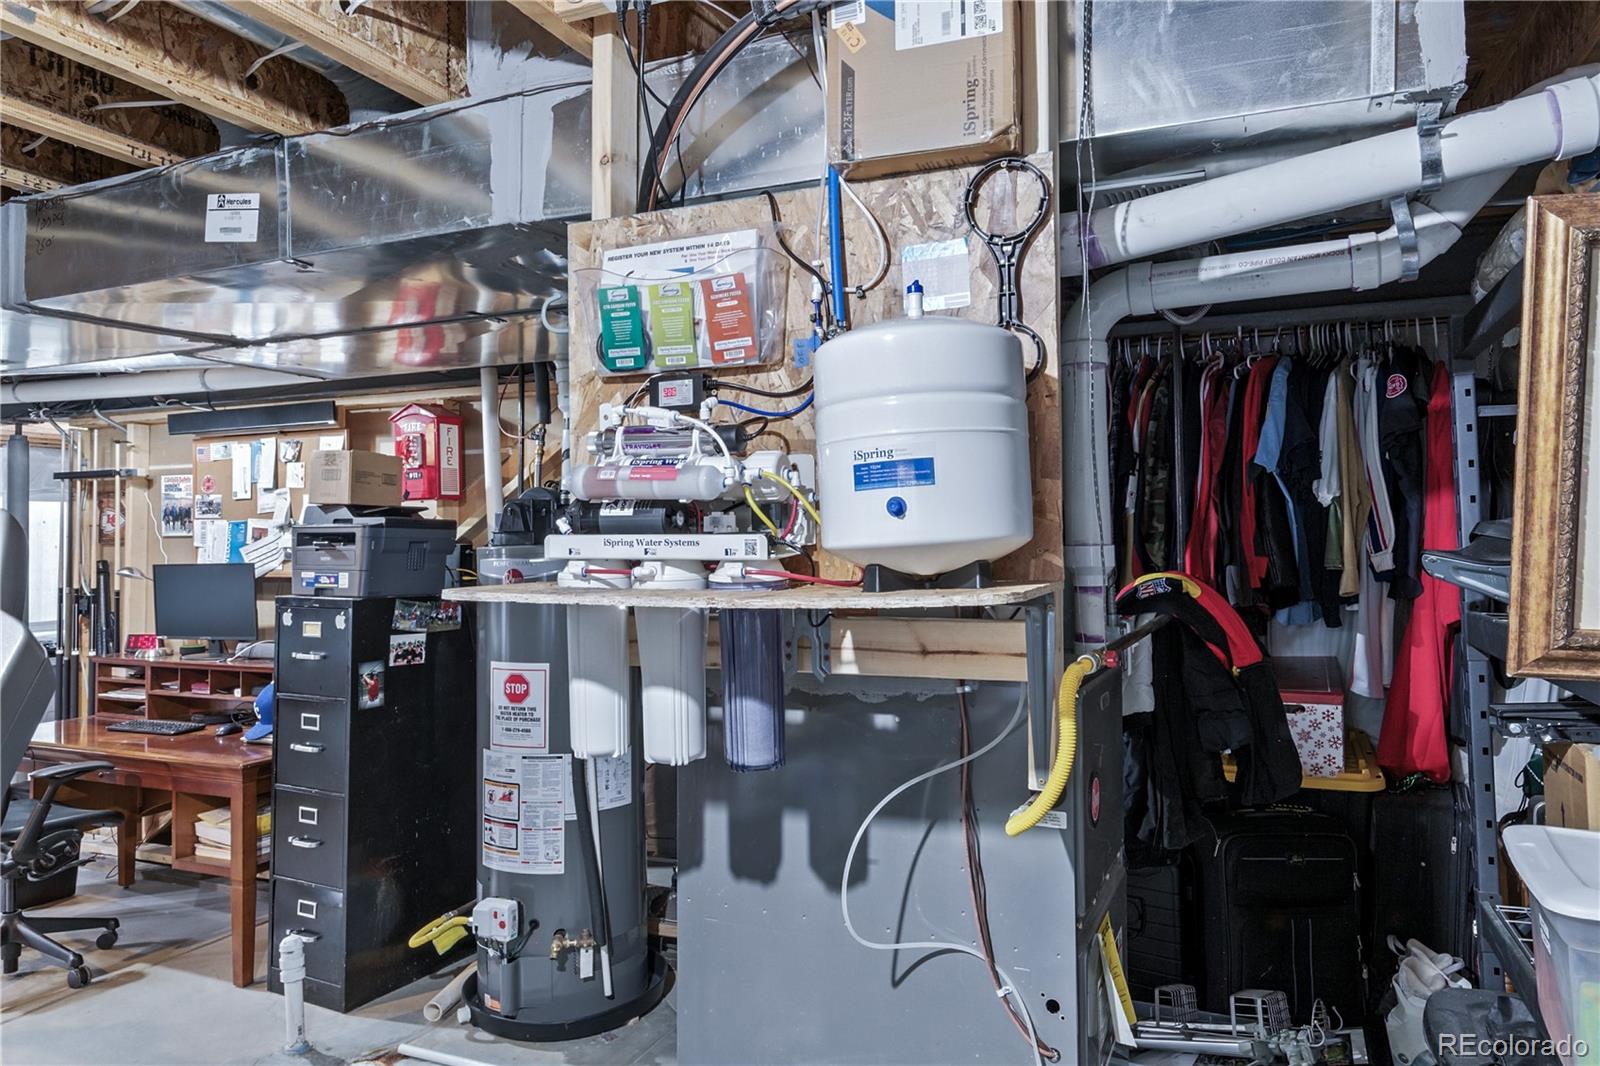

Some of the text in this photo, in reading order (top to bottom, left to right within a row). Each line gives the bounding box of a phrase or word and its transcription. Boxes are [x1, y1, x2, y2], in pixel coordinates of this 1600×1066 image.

[963, 78, 979, 136] iSpring
[607, 251, 633, 262] REGISTER
[634, 251, 648, 259] YOUR
[649, 249, 661, 257] NEW
[662, 246, 685, 255] SYSTEM
[686, 243, 706, 252] WITHIN
[854, 448, 894, 462] iSpring
[632, 458, 662, 466] iSpring
[603, 538, 700, 548] iSpring Water Systems
[505, 683, 527, 694] STOP
